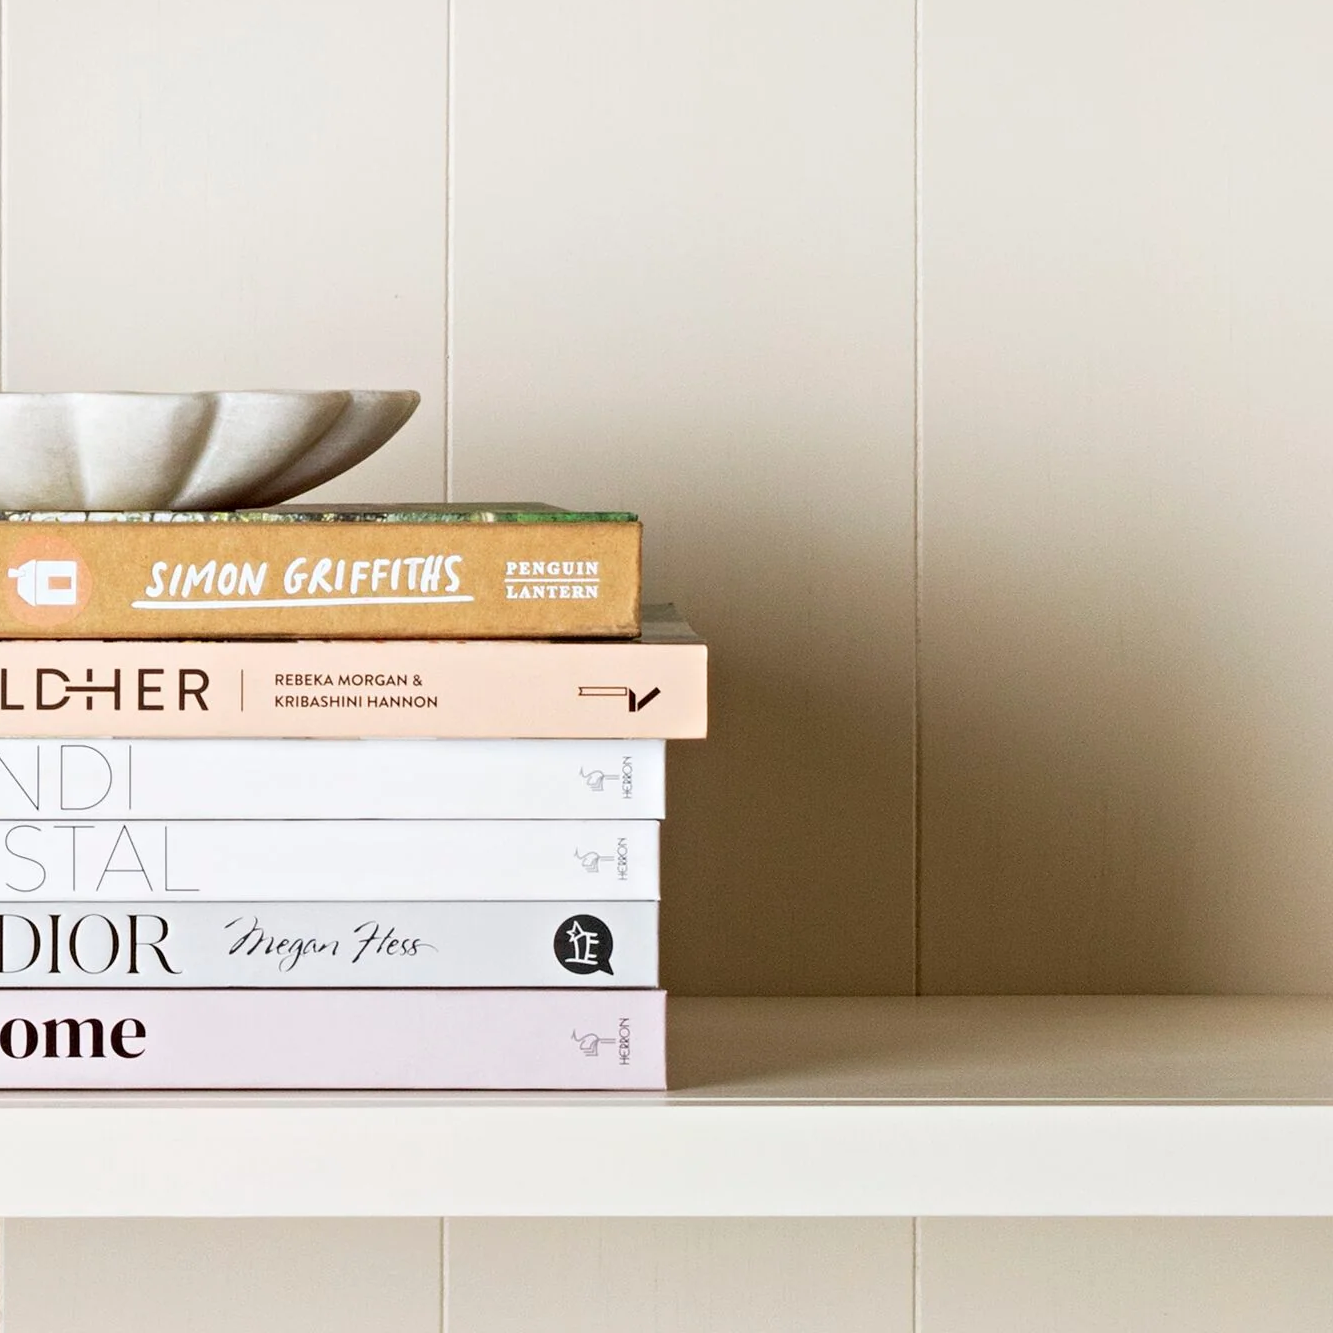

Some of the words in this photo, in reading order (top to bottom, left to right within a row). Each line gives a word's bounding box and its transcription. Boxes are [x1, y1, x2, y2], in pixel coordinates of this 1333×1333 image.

[145, 560, 268, 598] SIMON
[283, 554, 464, 596] GRIFFITHS
[505, 560, 600, 577] PENGUIN
[505, 584, 600, 600] LANTERN
[274, 673, 335, 688] REBEKA
[338, 673, 409, 688] MORGAN
[412, 673, 423, 688] &
[274, 694, 364, 710] KRIBASHINI
[366, 694, 439, 710] HANNON
[223, 916, 341, 973] Megan
[352, 920, 440, 965] Hess
[619, 1018, 630, 1065] HERRON
